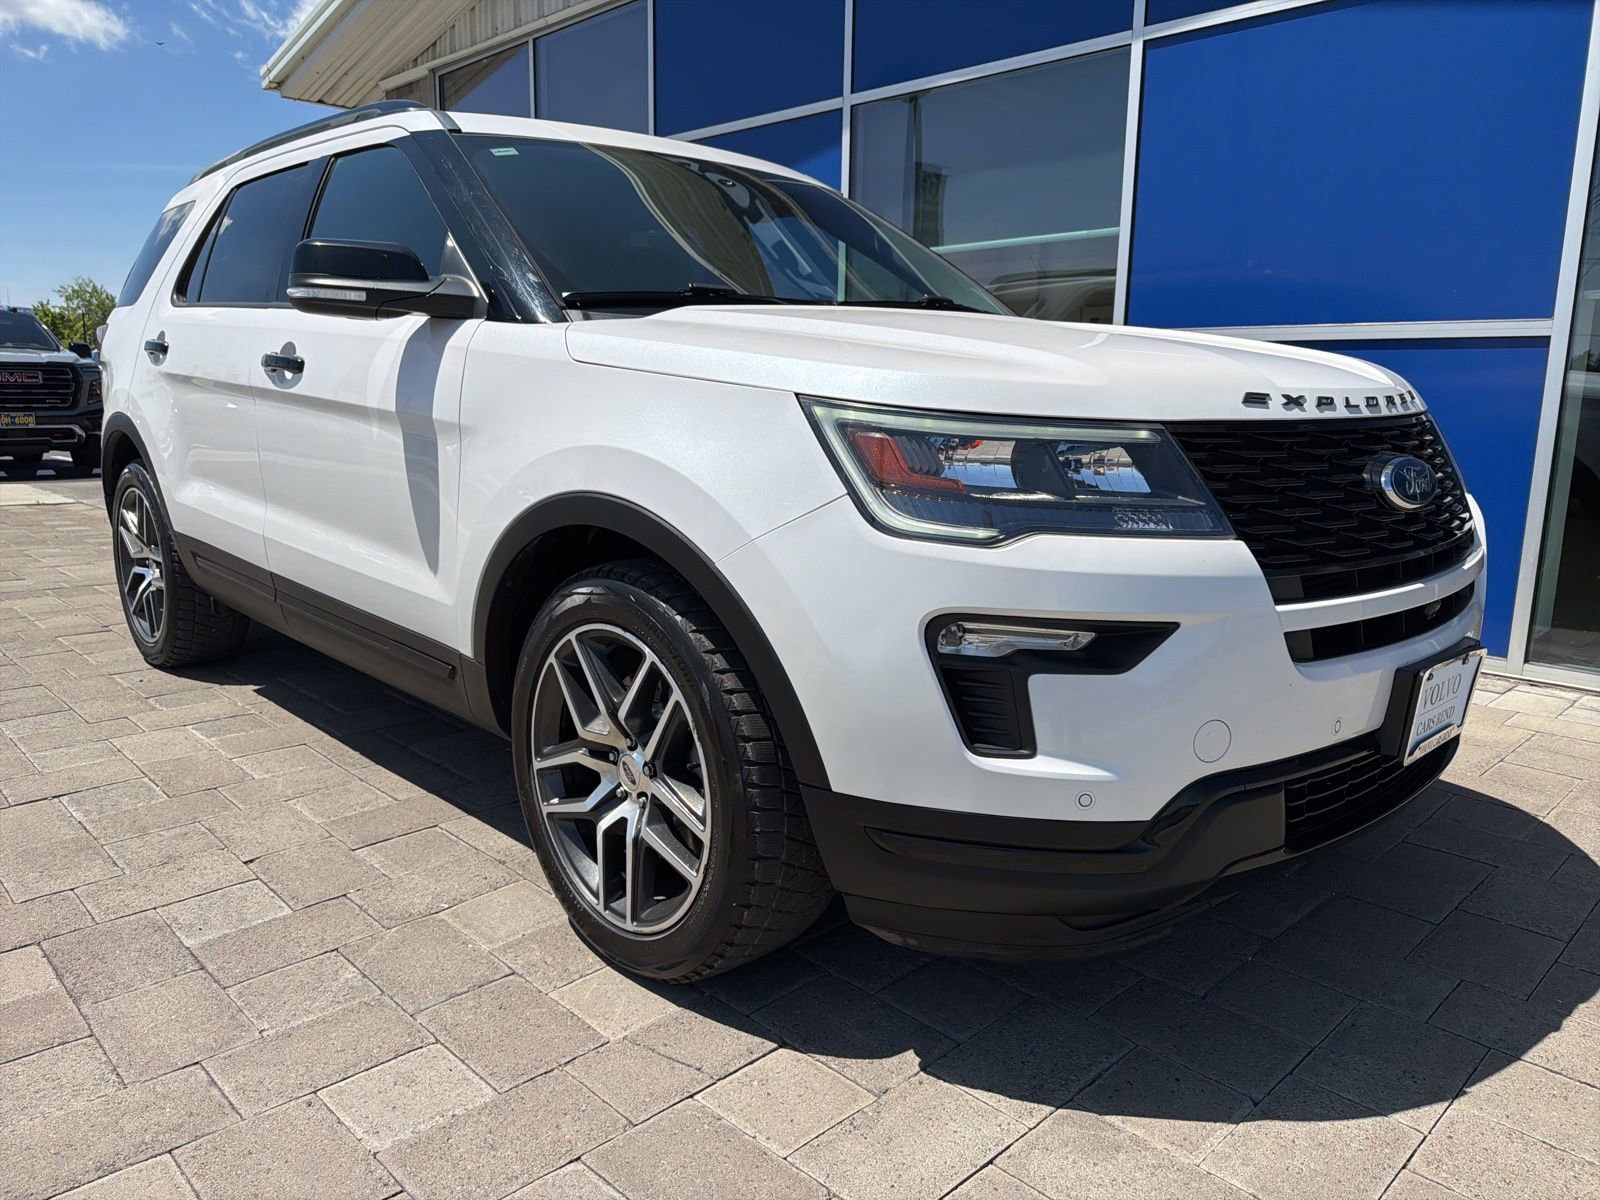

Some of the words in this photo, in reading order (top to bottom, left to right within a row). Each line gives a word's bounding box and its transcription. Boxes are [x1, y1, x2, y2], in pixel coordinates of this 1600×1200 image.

[0, 372, 40, 383] MC
[1399, 464, 1433, 499] Ford
[1422, 673, 1462, 708] VOLVO
